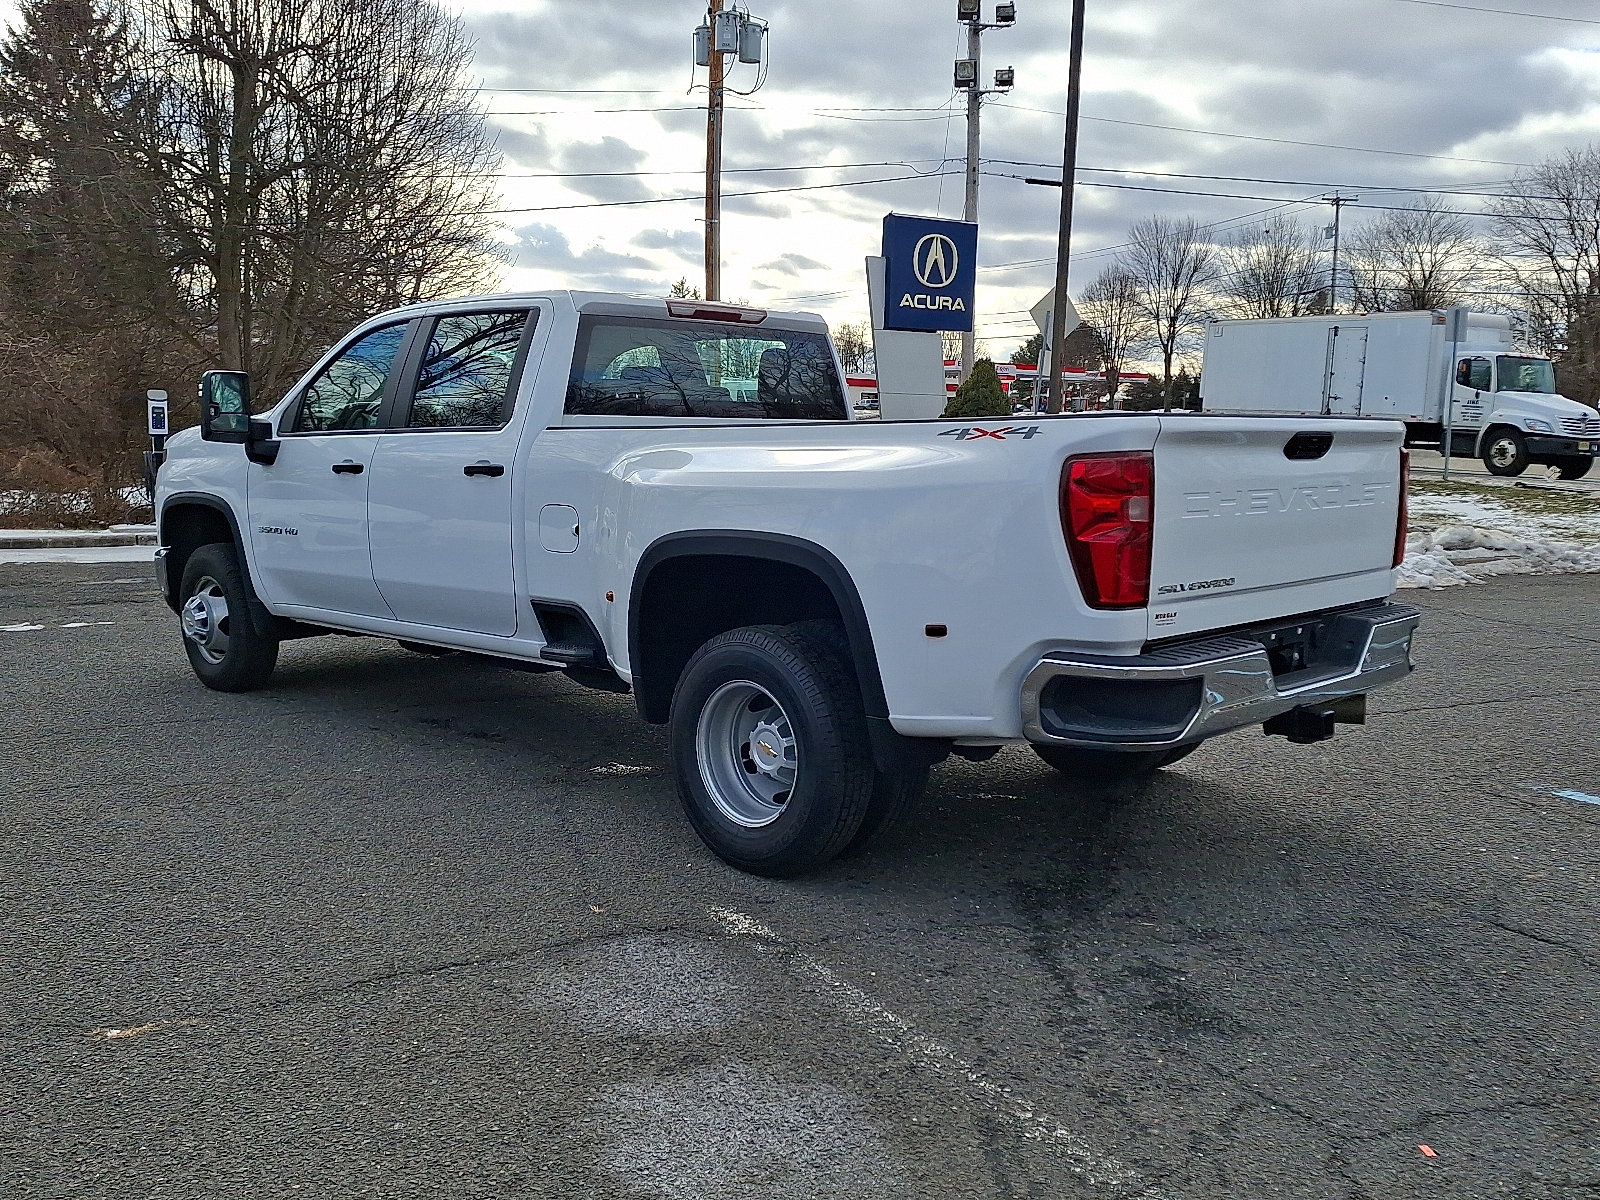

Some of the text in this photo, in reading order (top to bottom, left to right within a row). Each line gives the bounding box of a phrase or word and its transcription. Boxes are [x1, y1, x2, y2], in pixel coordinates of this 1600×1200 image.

[900, 293, 965, 311] ACURA
[1182, 481, 1392, 519] CHEVROLET
[258, 526, 283, 534] 3500
[1158, 577, 1236, 595] SILVERADO
